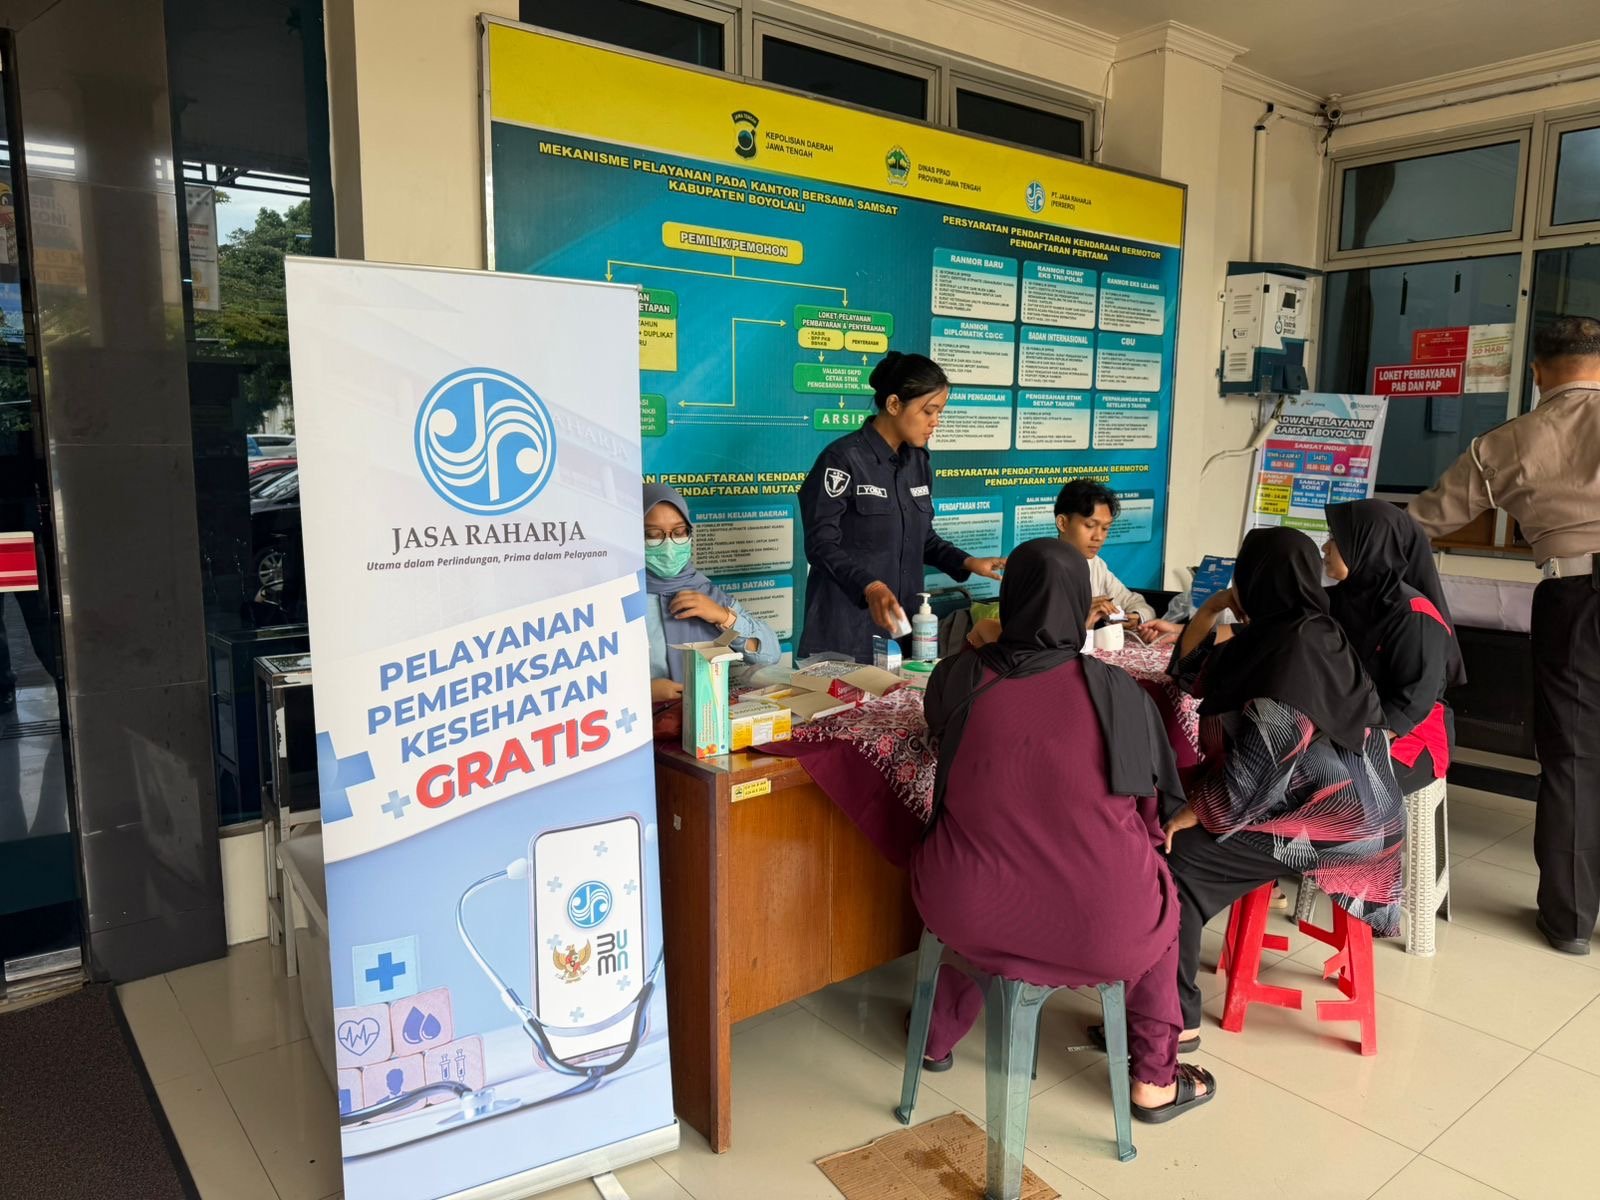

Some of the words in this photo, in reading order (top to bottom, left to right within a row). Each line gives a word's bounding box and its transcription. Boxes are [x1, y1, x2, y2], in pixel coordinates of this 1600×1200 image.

[765, 132, 806, 147] KEPOLISIAN
[807, 140, 834, 152] DAERAH
[765, 142, 785, 153] JAWA
[786, 147, 813, 158] TENGAH
[918, 164, 935, 174] DINAS
[539, 142, 630, 169] MEKANISME
[633, 159, 712, 185] PELAYANAN
[715, 173, 748, 190] PADA
[750, 180, 800, 199] KANTOR
[803, 191, 855, 209] BERSAMA
[857, 200, 899, 216] SAMSAT
[918, 173, 944, 185] PROVINSI
[944, 178, 959, 188] JAWA
[961, 182, 982, 193] TENGAH
[668, 180, 746, 203] KABUPATEN
[749, 194, 806, 213] BOYOLALI
[1051, 200, 1076, 211] (PERSERO)
[942, 215, 1009, 235] PERSYARATAN
[1011, 227, 1072, 245] PENDAFTARAN
[1073, 238, 1121, 253] KENDARAAN
[1122, 246, 1161, 260] BERMOTOR
[680, 231, 788, 258] PEMILIK/PEMOHON
[1010, 238, 1072, 257] PENDAFTARAN
[1072, 248, 1109, 262] PERTAMA
[951, 255, 983, 268] RANMOR
[983, 260, 1004, 270] BARU
[1037, 265, 1065, 277] RANMOR
[1066, 269, 1084, 278] DUMP
[1038, 272, 1051, 280] EKS
[1107, 277, 1129, 287] RANMOR
[1129, 280, 1140, 288] EKS
[1140, 281, 1160, 291] LELANG
[818, 312, 838, 321] LOKET
[838, 313, 872, 323] PELAYANAN
[802, 319, 841, 329] PEMBAYARAN
[849, 323, 886, 333] PENYERAHAN
[960, 322, 989, 331] RANMOR
[643, 330, 674, 339] DUPLIKAT
[944, 328, 984, 339] DIPLOMATIK
[1028, 332, 1045, 342] BADAN
[1045, 333, 1089, 345] INTERNASIONAL
[1121, 337, 1136, 346] CBU
[822, 368, 847, 376] VALIDASI
[1379, 368, 1403, 380] LOKET
[1404, 368, 1457, 379] PEMBAYARAN
[825, 375, 842, 383] CETAK
[807, 382, 843, 390] PENGESAHAN
[1391, 381, 1407, 392] PAB
[1407, 381, 1424, 392] DAN
[1424, 380, 1442, 391] PAP
[967, 393, 1006, 402] PENGADILAN
[1025, 393, 1065, 401] PENGESAHAN
[1066, 394, 1082, 402] STNK
[1055, 400, 1075, 408] TAHUN
[1312, 418, 1374, 429] PELAYANAN
[1275, 426, 1313, 436] SAMSAT
[1315, 428, 1366, 440] BOYOLALI
[1323, 444, 1347, 452] INDUK
[935, 468, 1000, 478] PERSYARATAN
[1001, 466, 1062, 475] PENDAFTARAN
[1063, 465, 1109, 474] KENDARAAN
[1110, 464, 1150, 473] BERMOTOR
[660, 473, 754, 485] PENDAFTARAN
[757, 472, 809, 483] KENDAR
[985, 477, 1046, 486] PENDAFTARAN
[676, 485, 759, 497] ENDAFTARAN
[938, 502, 976, 512] PENDAFTARAN
[696, 511, 727, 520] MUTASI
[730, 510, 756, 519] KELUAR
[757, 508, 788, 518] DAERAH
[391, 525, 459, 556] JASA
[465, 520, 586, 546] RAHARJA
[366, 560, 401, 572] Utama
[403, 557, 435, 570] dalam
[436, 553, 501, 569] Perlindungan,
[503, 552, 532, 563] Prima
[533, 550, 562, 562] dalam
[563, 548, 608, 562] Pelayanan
[744, 579, 776, 588] DATANG
[380, 603, 595, 692] PELAYANAN
[367, 631, 619, 736] PEMERIKSAAN
[401, 670, 608, 764] KESEHATAN
[416, 709, 611, 809] GRATIS
